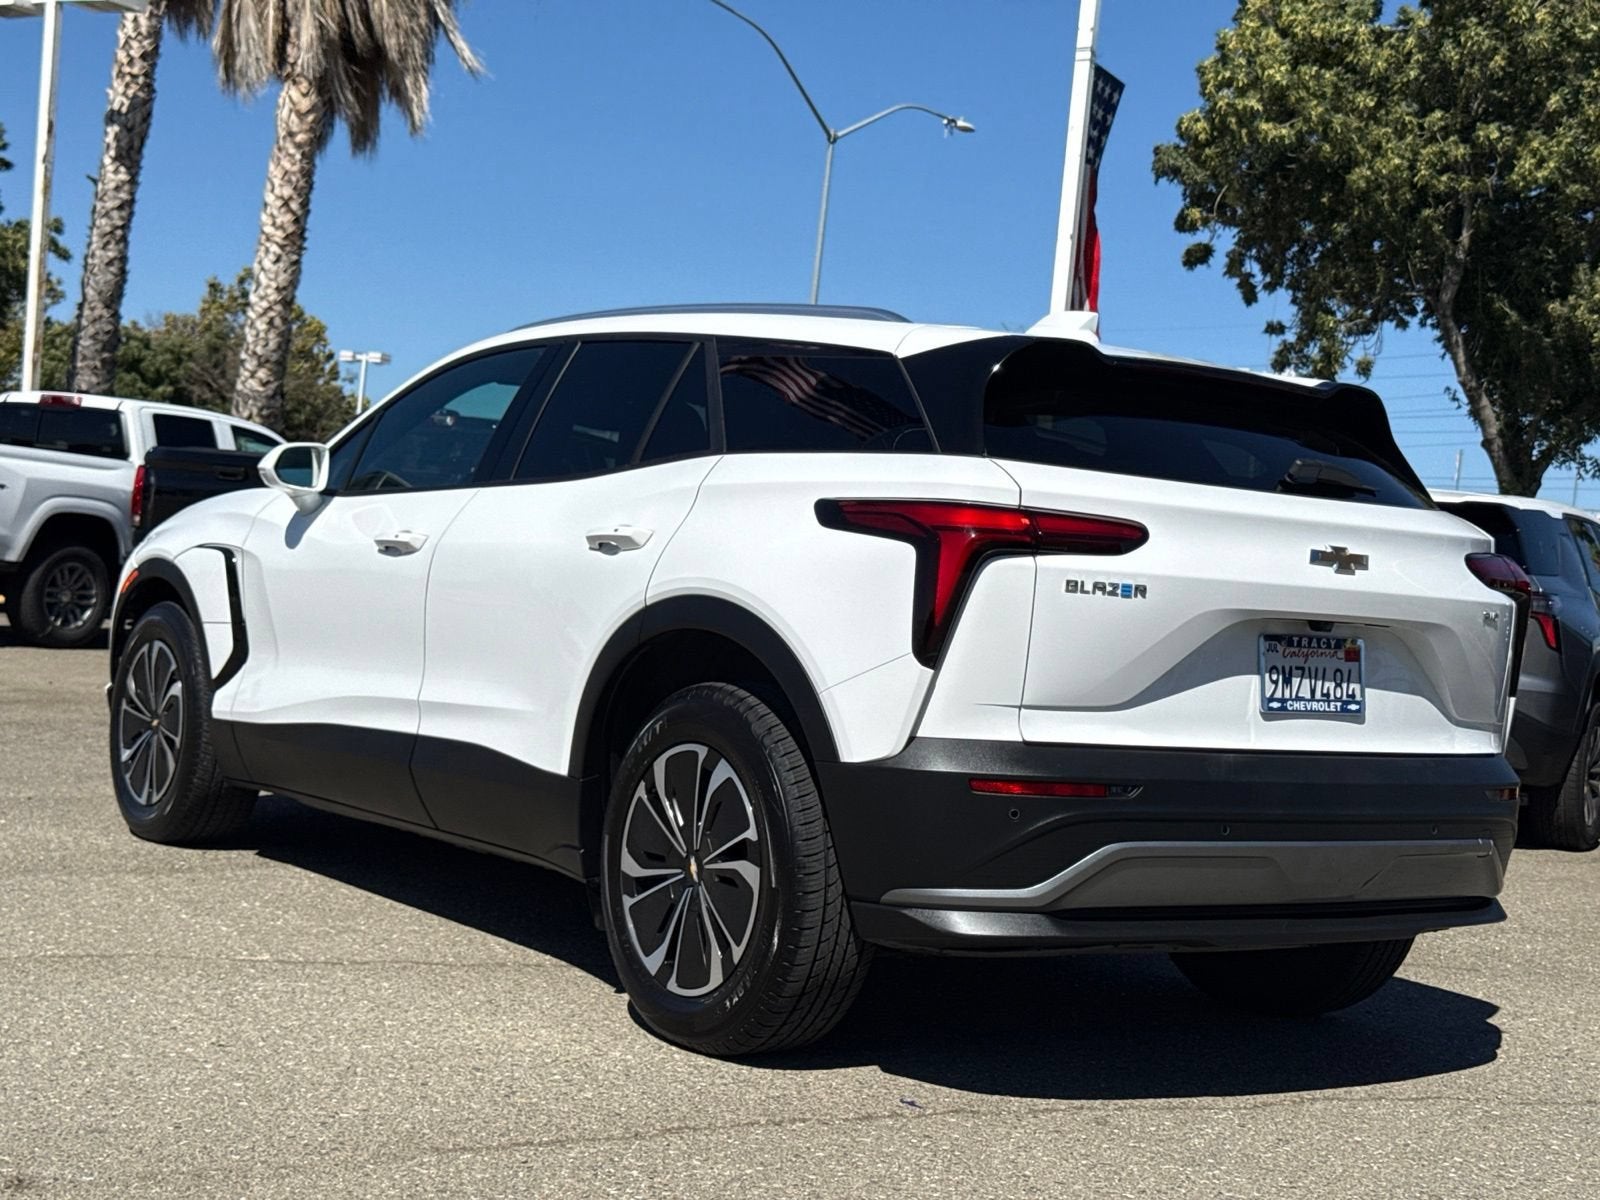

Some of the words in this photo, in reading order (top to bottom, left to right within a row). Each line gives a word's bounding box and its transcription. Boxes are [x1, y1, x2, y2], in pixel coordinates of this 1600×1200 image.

[1065, 579, 1147, 599] BLAZER
[1292, 637, 1336, 649] TRACY
[1282, 648, 1344, 664] California
[1269, 665, 1356, 700] 9MZV484
[1287, 701, 1342, 712] CHEVROLET
